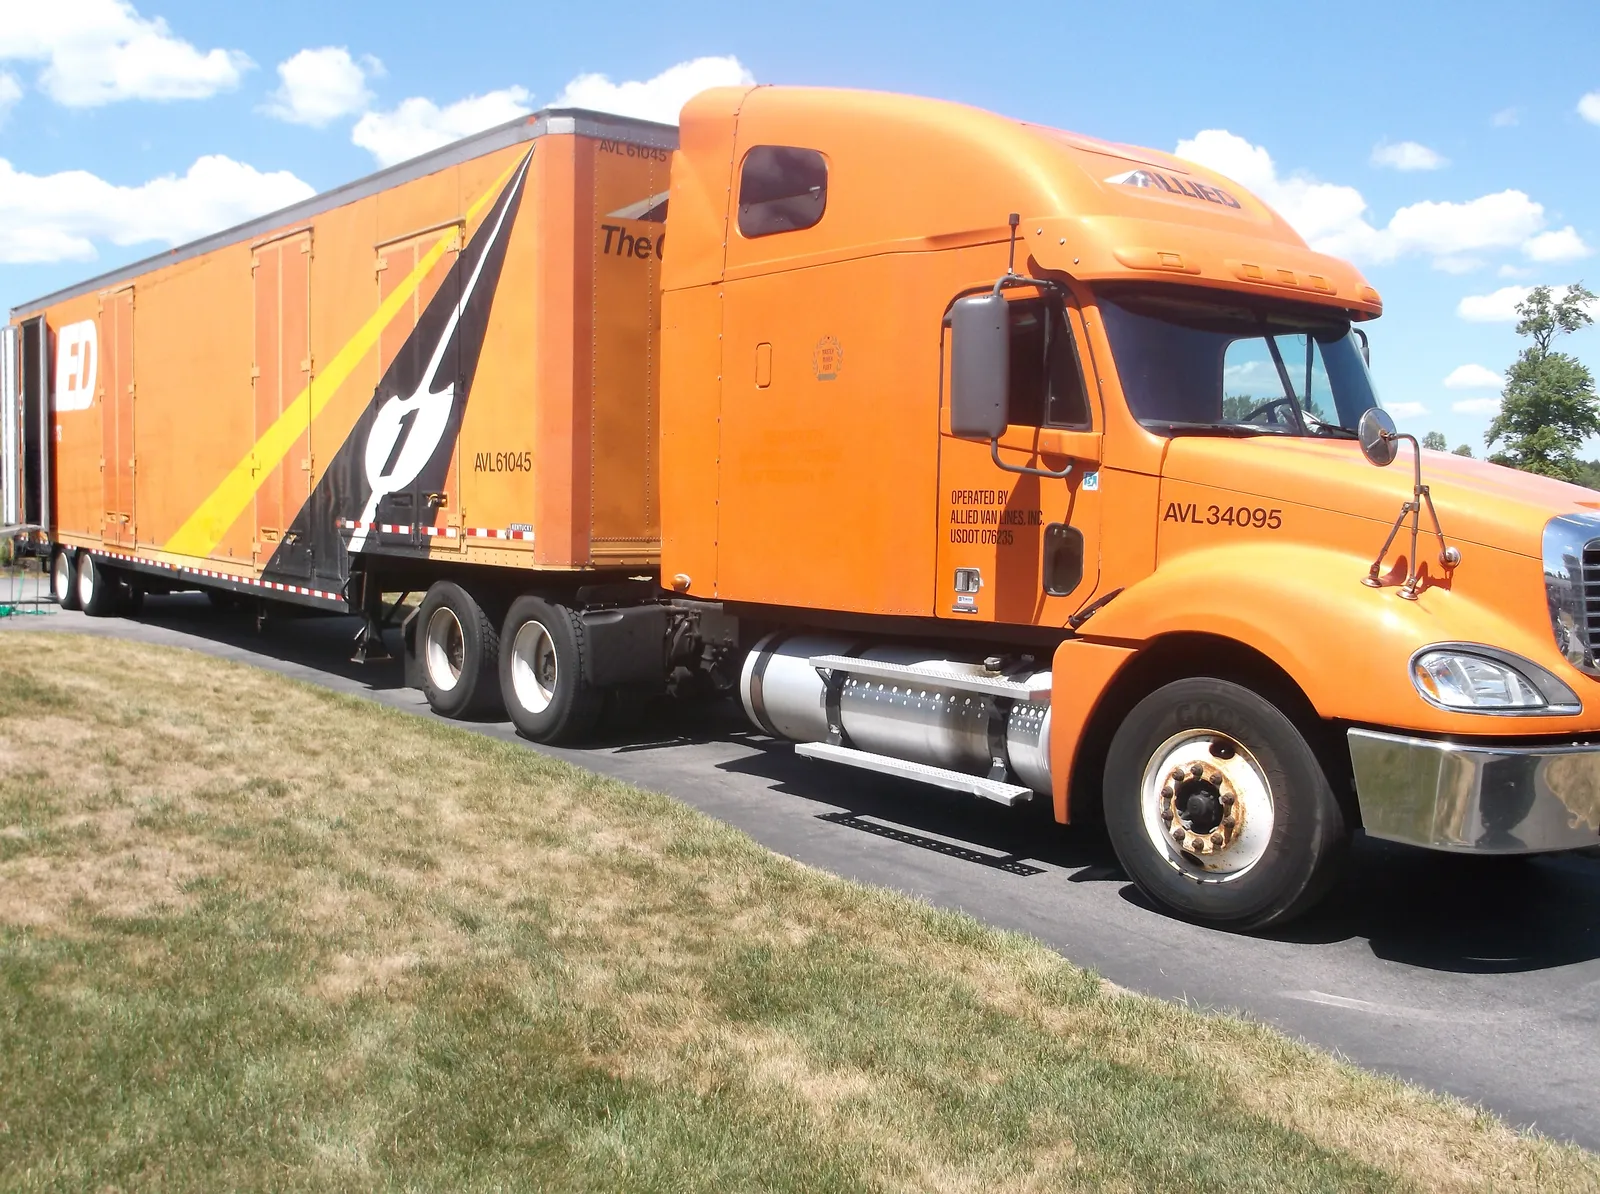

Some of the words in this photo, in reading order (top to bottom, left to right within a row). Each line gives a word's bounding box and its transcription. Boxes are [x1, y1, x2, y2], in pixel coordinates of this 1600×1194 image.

[600, 139, 624, 155] AVL
[626, 144, 667, 162] 61045
[1121, 169, 1241, 209] ALLIED
[601, 224, 652, 259] The
[379, 408, 420, 477] 1
[951, 490, 995, 505] OPERATED
[997, 490, 1009, 505] BY
[950, 510, 979, 524] ALLIED
[980, 510, 998, 525] VAN
[950, 529, 980, 544] USDOT
[981, 530, 1014, 545] 076235
